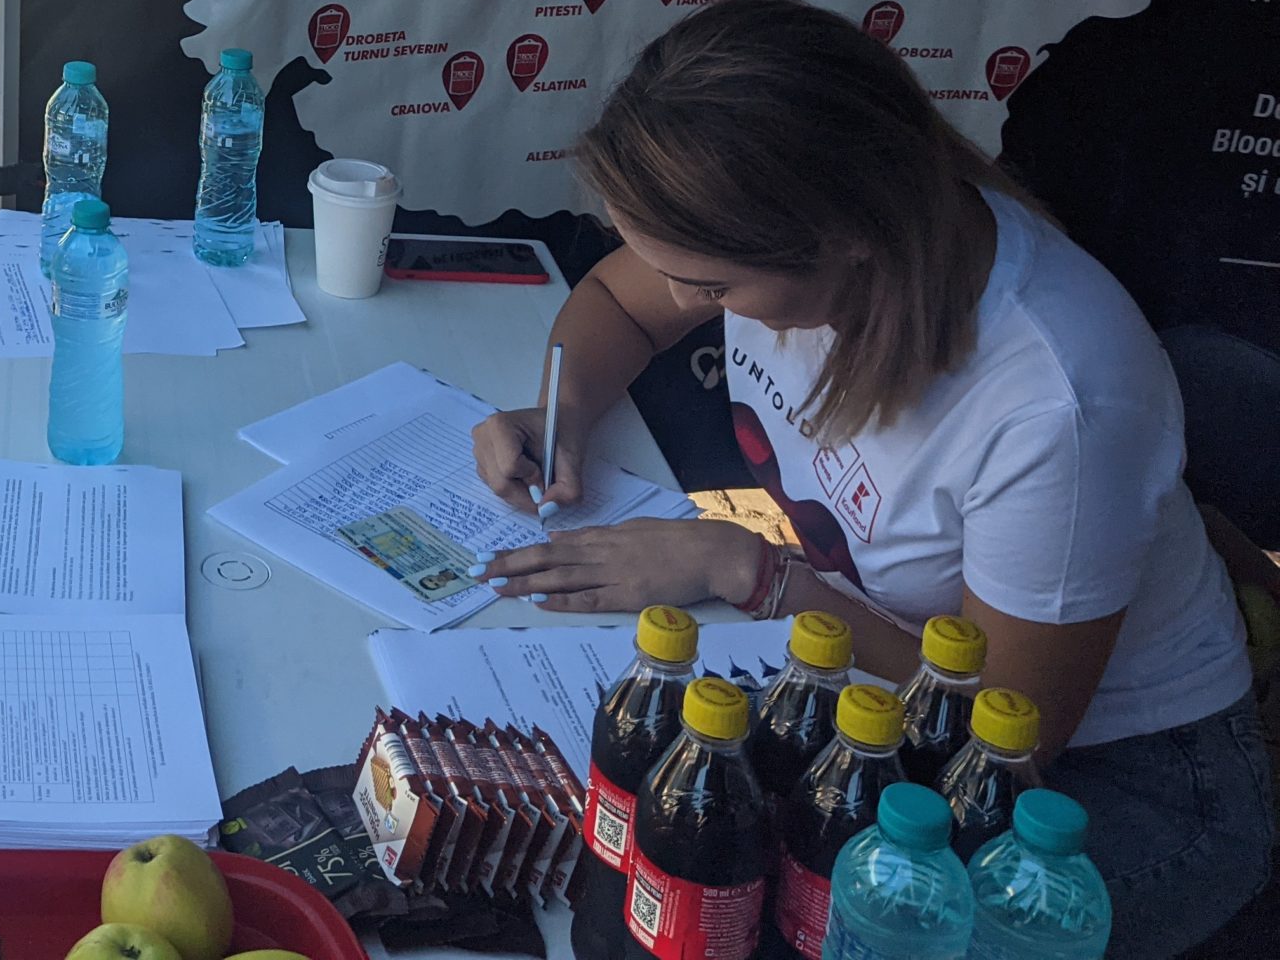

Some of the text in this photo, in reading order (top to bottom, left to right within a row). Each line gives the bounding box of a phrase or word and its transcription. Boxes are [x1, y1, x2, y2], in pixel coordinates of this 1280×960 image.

[535, 5, 582, 18] PITESTI
[346, 32, 406, 46] DROBETA
[344, 43, 448, 62] TURNU SEVERIN
[897, 48, 953, 58] OBOZIA
[533, 79, 587, 92] SLATINA
[929, 90, 989, 100] NSTANTA
[391, 102, 450, 116] CRAIOVA
[732, 347, 814, 439] UNTOLD
[841, 497, 866, 533] Kaufland
[314, 847, 353, 885] 75%
